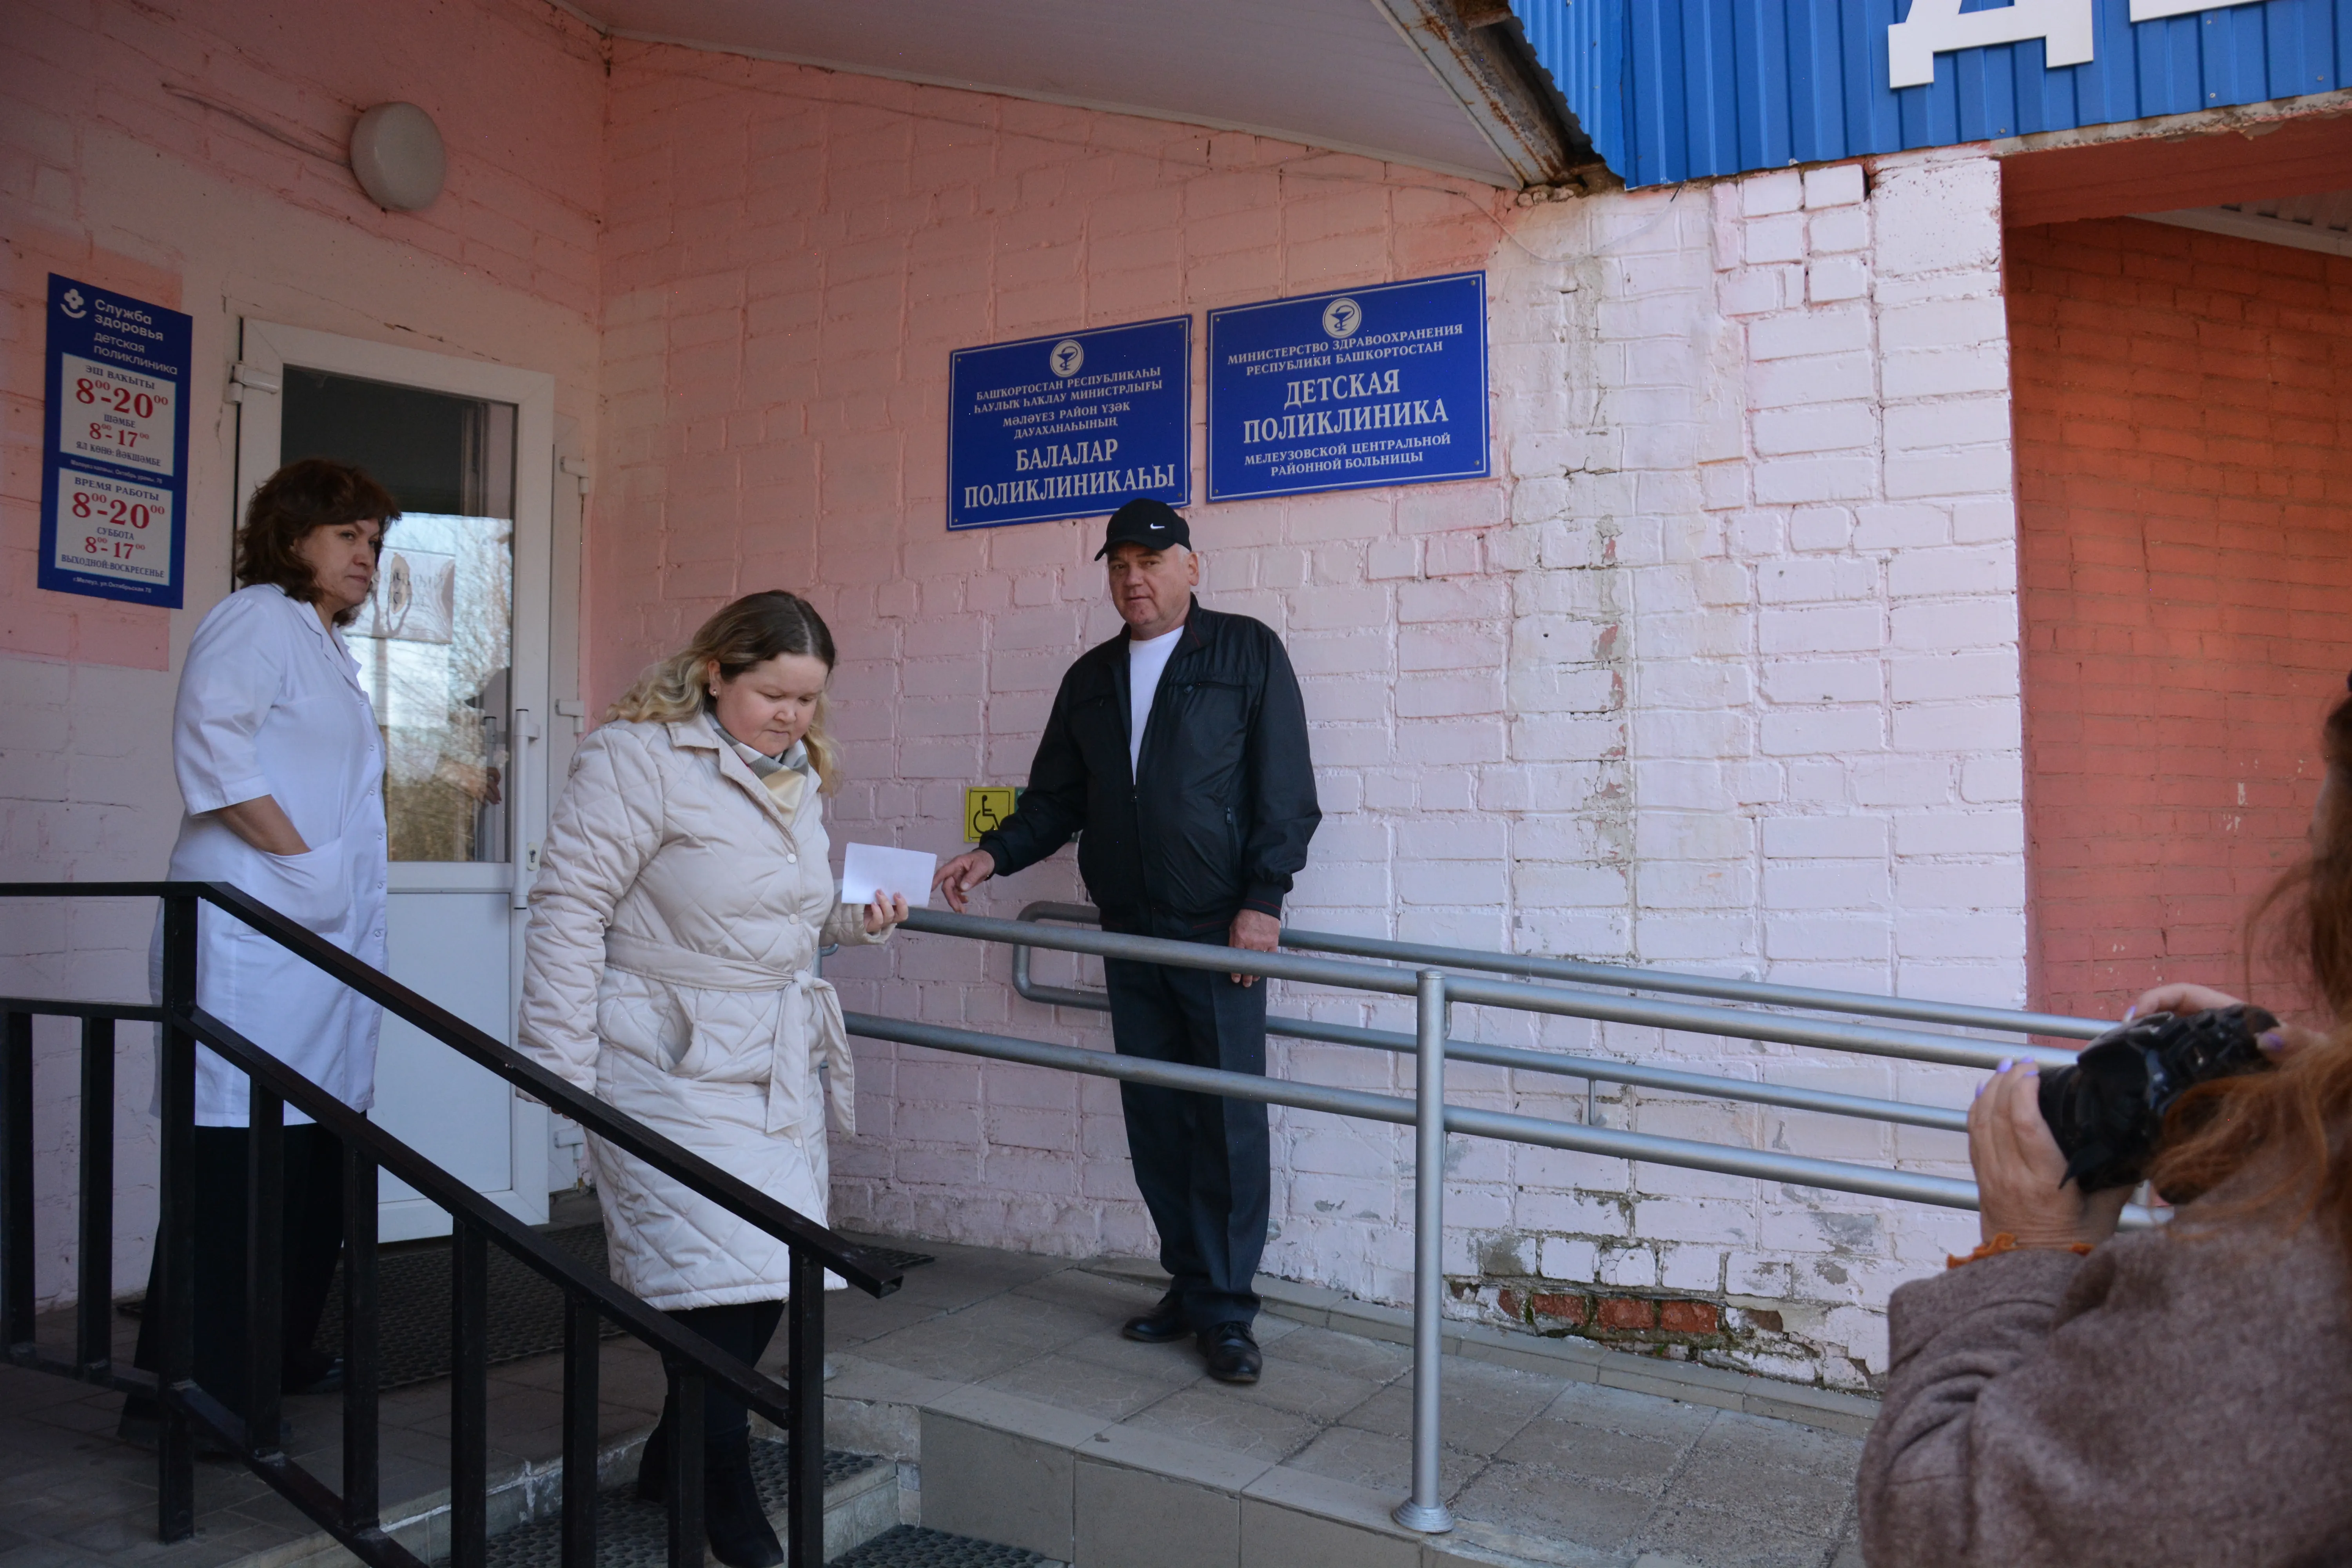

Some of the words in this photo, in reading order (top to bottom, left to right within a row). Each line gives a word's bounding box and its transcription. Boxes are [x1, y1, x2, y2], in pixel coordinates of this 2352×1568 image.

[95, 299, 152, 325] Служба
[94, 314, 163, 341] здоровья
[94, 332, 145, 353] детская
[1228, 342, 1328, 365] МИНИСТЕРСТВО
[1333, 324, 1463, 350] ЗДРАВООХРАНЕНИЯ
[85, 365, 103, 376] ЭШ
[94, 346, 178, 375] поликлиника
[1246, 355, 1331, 376] РЕСПУБЛИКИ
[1336, 341, 1443, 364] БАШКОРТОСТАН
[1284, 369, 1400, 410] ДЕТСКАЯ
[1060, 406, 1097, 418] РАЙОН
[1243, 398, 1448, 443] ПОЛИКЛИНИКА
[1016, 438, 1118, 471] БАЛАЛАР
[1245, 443, 1347, 465] МЕЛЕУЗОВСКОЙ
[1351, 432, 1450, 454] ЦЕНТРАЛЬНОЙ
[1271, 458, 1341, 476] РАЙОННОЙ
[1345, 451, 1423, 469] БОЛЬНИЦЫ
[75, 477, 111, 492] ВРЕМЯ
[116, 486, 160, 501] РАБОТЫ
[964, 464, 1175, 508] ПОЛИКЛИНИКАҺЫ
[97, 527, 134, 540] СУББОТА
